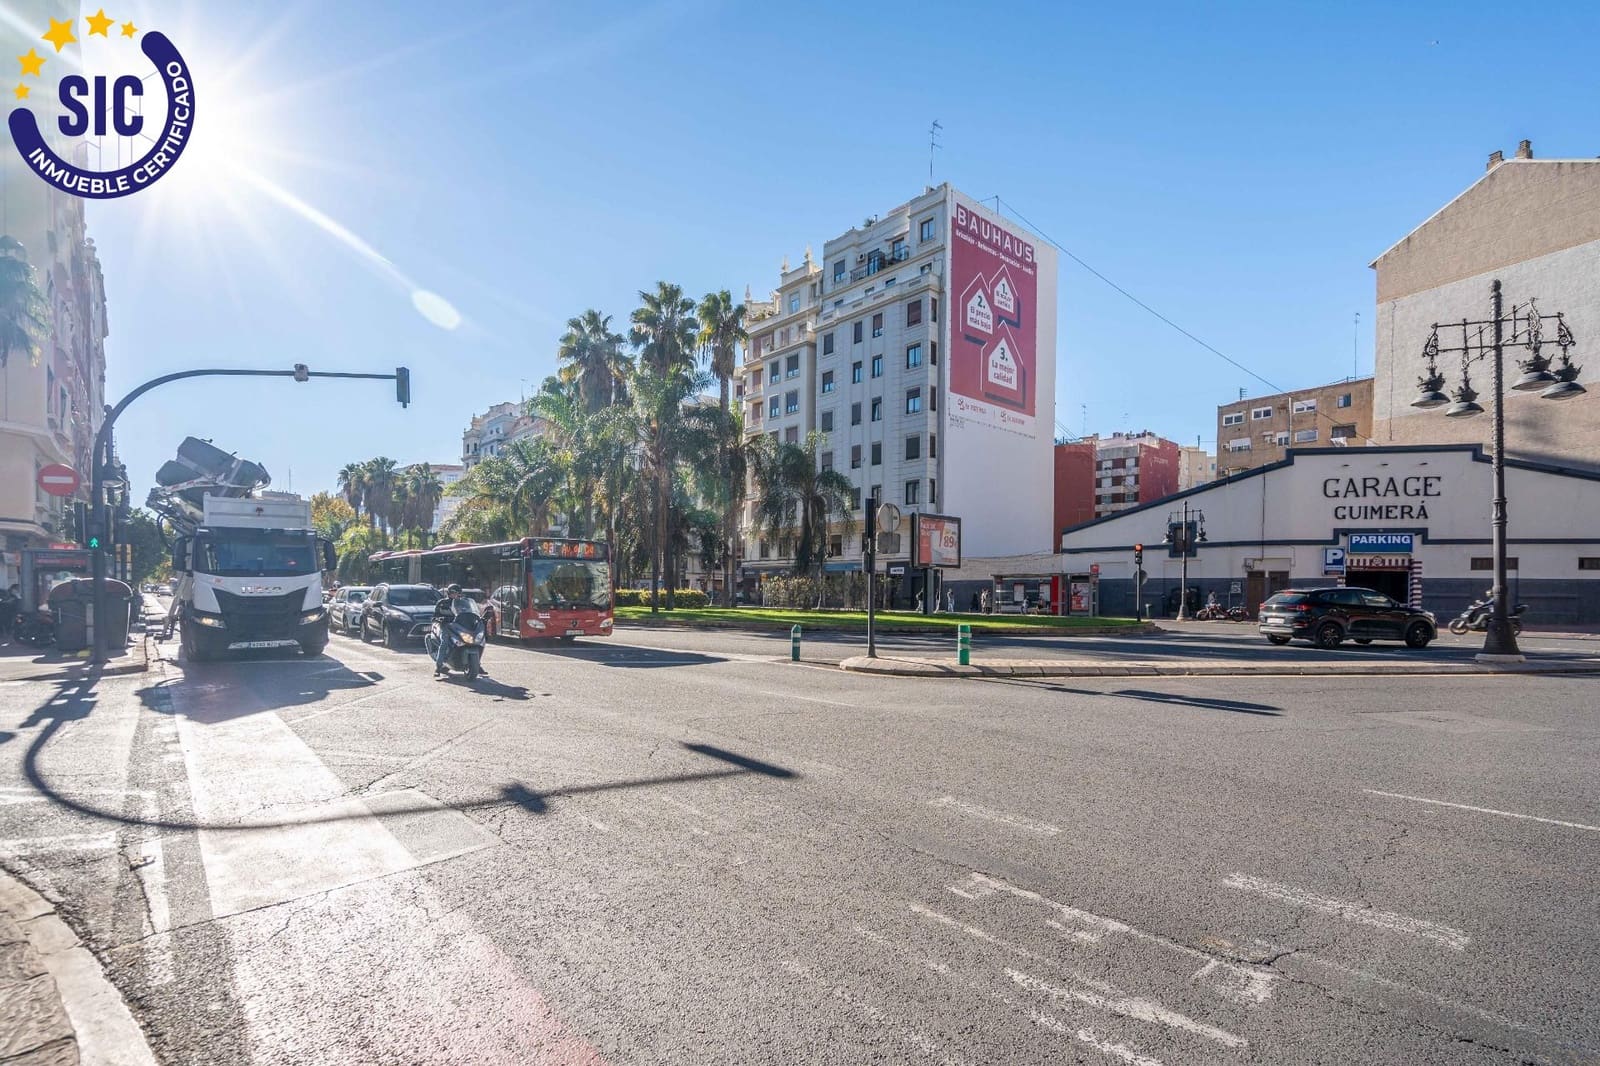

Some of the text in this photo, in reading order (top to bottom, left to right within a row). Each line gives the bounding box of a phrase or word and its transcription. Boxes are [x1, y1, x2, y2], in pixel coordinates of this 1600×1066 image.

[958, 208, 1033, 262] BAUHAUS
[978, 295, 985, 309] 2.
[1000, 347, 1008, 361] 3.
[992, 359, 998, 369] La
[1323, 476, 1441, 498] GARAGE
[1334, 500, 1429, 520] GUIMERÁ
[1352, 535, 1411, 544] PARKING
[1327, 549, 1344, 564] P
